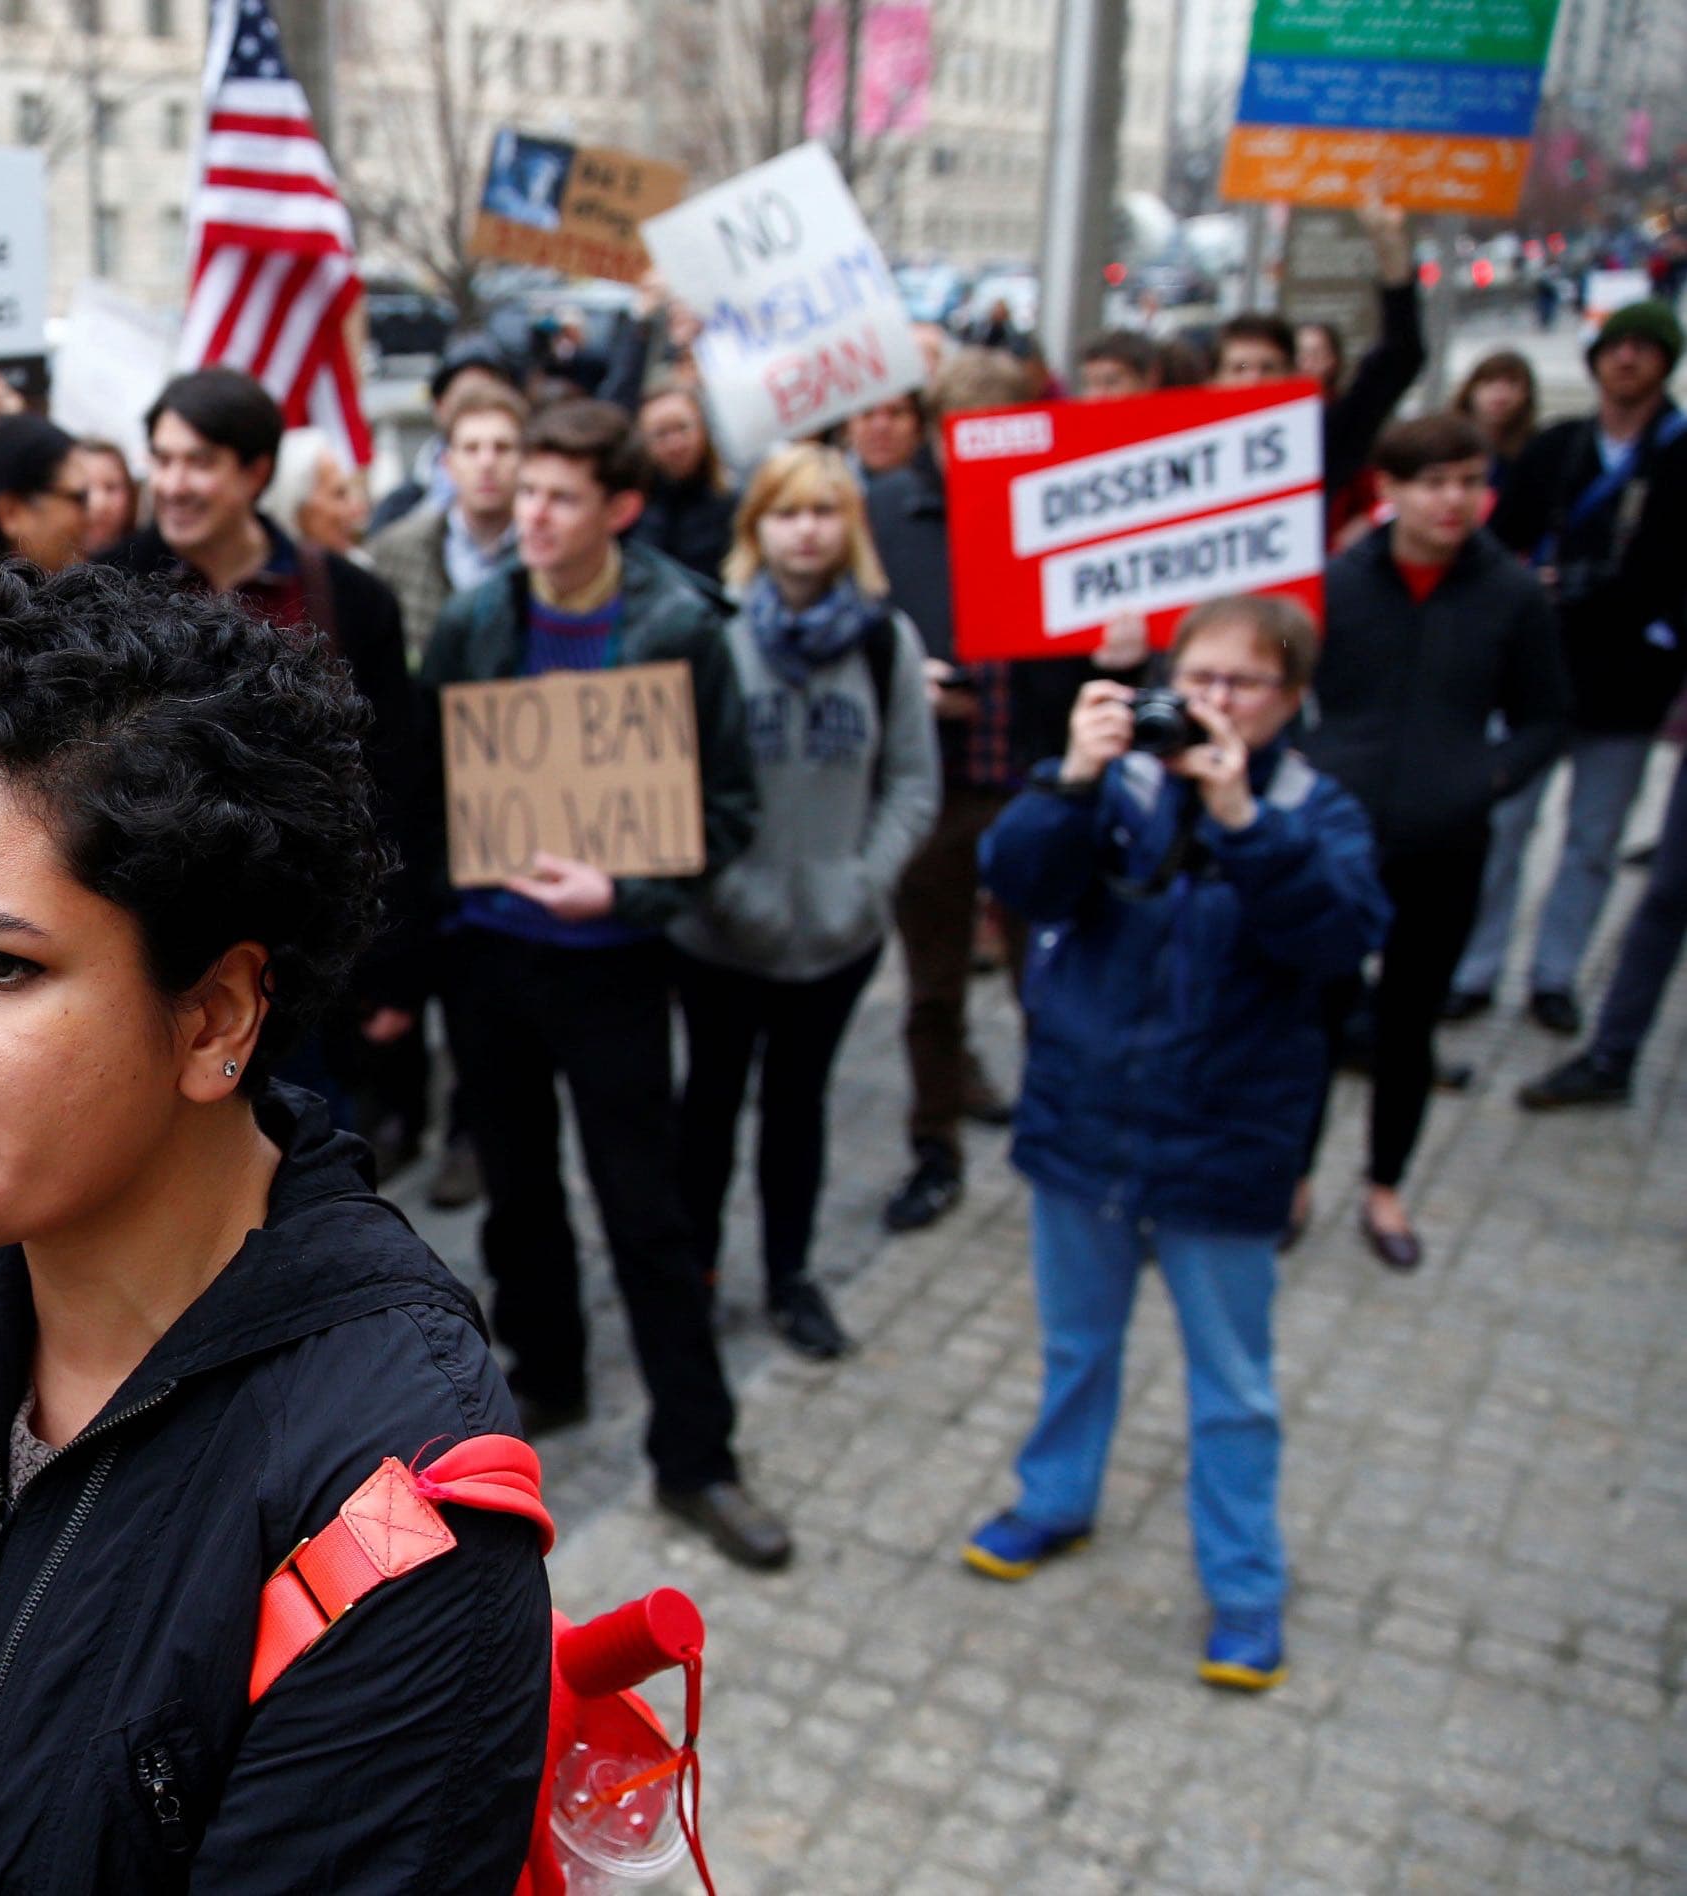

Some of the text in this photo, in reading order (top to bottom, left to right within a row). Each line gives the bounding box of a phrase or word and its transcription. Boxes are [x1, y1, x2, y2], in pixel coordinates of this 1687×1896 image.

[715, 190, 804, 278] NO
[763, 322, 889, 425] BAN
[1041, 424, 1288, 528] DISSENT IS
[1073, 516, 1289, 606] PATRIOTIC
[453, 687, 552, 773] NO
[577, 679, 694, 768] BAN
[451, 784, 701, 876] NO WALL
